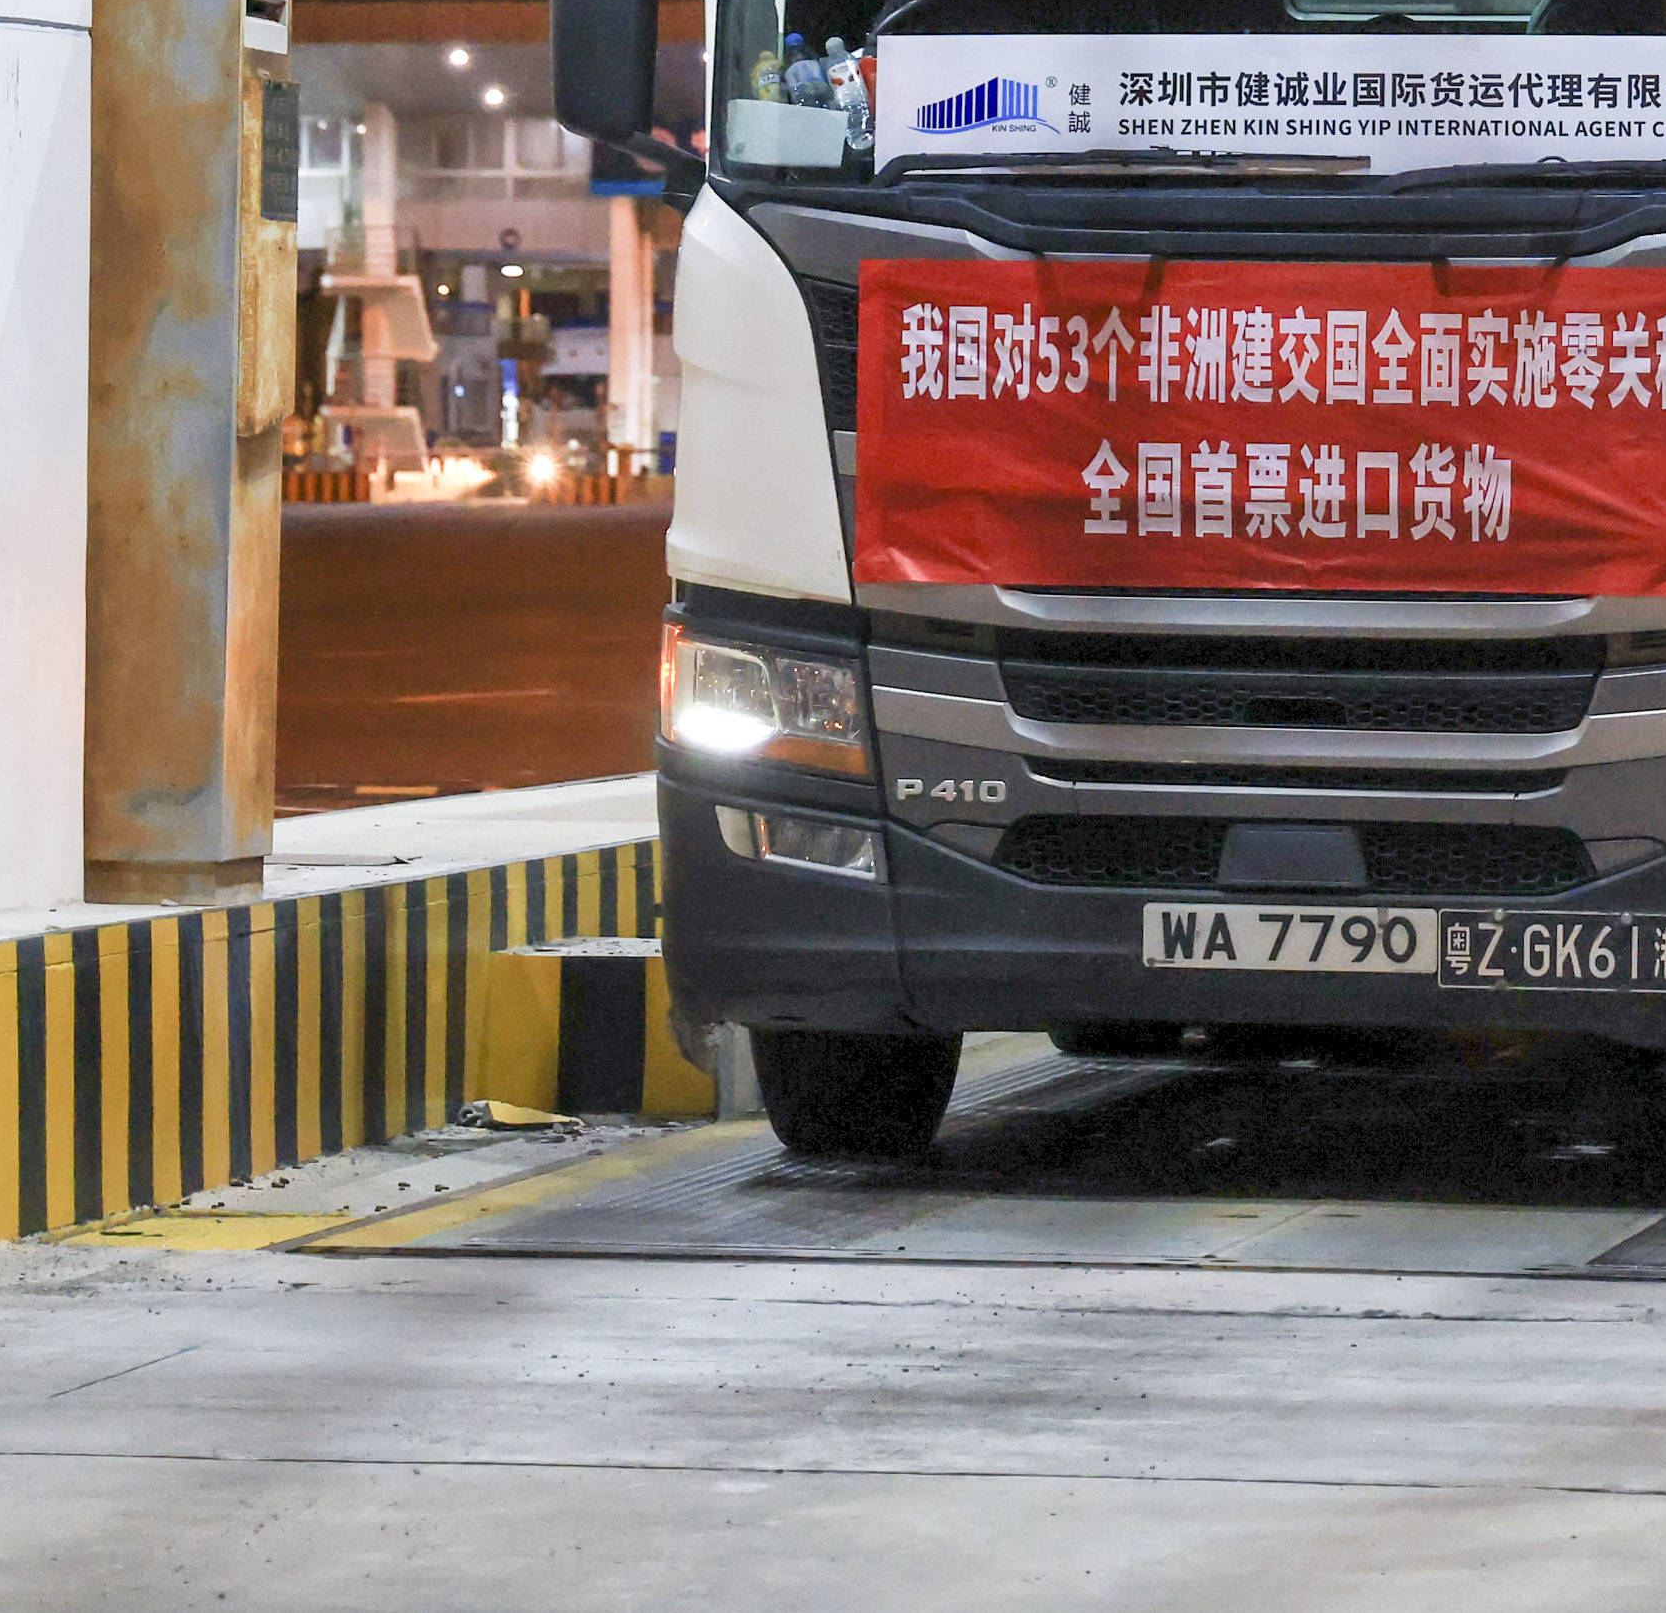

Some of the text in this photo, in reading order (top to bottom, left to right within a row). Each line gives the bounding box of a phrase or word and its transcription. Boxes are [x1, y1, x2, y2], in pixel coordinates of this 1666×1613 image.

[1067, 82, 1092, 135] 健誠
[1118, 118, 1174, 136] SHEN
[1180, 118, 1237, 136] ZHEN
[1244, 119, 1279, 136] KIN
[1285, 119, 1352, 136] SHING
[1357, 119, 1391, 136] YIP
[1398, 119, 1569, 137] INTERNATIONAL
[1574, 120, 1647, 137] AGENT
[991, 124, 1037, 133] KIN SHING
[1080, 438, 1513, 543] 全国首票进口货物
[896, 779, 1007, 803] P 410
[1161, 912, 1418, 964] WA 7790
